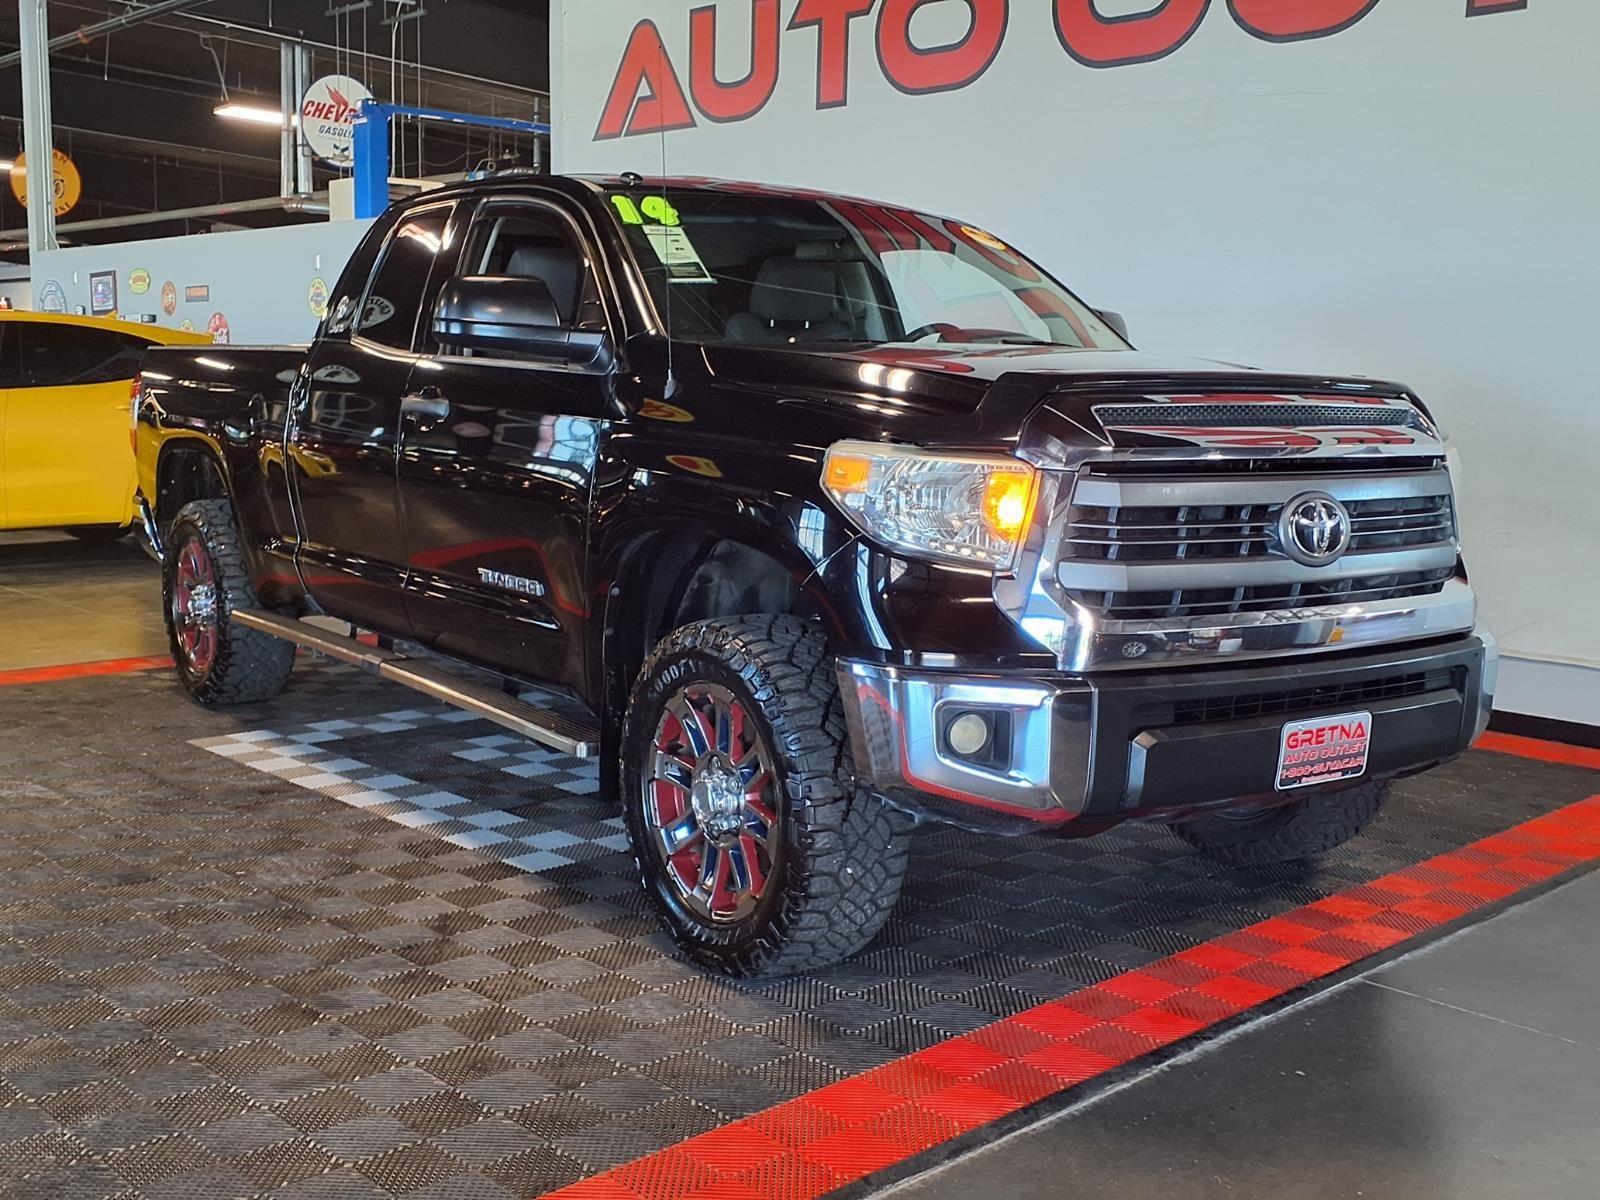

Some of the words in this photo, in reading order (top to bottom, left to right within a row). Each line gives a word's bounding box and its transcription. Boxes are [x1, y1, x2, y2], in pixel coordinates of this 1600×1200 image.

[592, 0, 1009, 142] AUTO
[303, 100, 358, 125] CHEVR
[319, 124, 354, 139] GASOLI
[1286, 722, 1366, 749] GRETNA
[1284, 750, 1318, 764] AUTO
[1320, 741, 1367, 759] OUTLET
